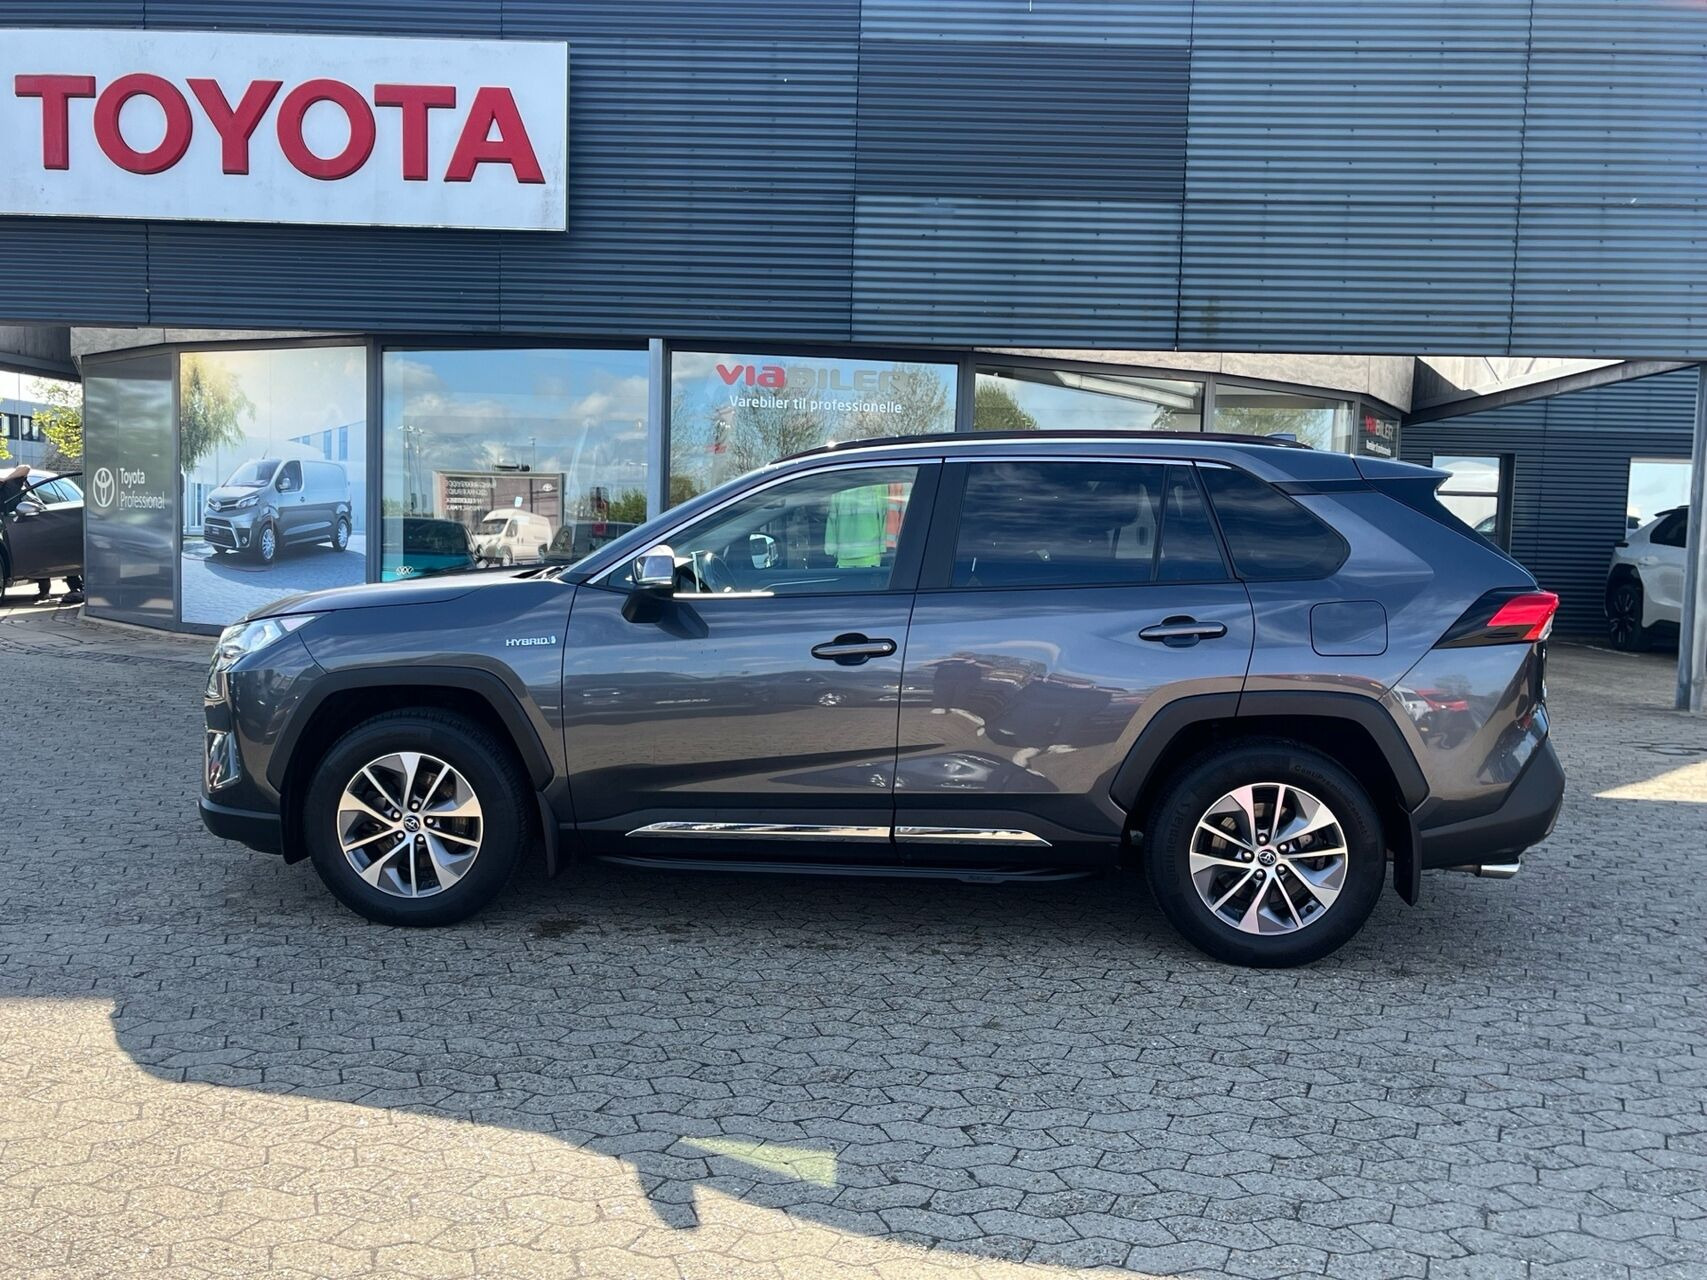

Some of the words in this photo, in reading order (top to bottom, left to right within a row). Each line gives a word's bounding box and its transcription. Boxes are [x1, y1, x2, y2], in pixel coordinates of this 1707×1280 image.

[15, 73, 546, 184] TOYOTA
[729, 395, 788, 409] Varebiler
[793, 398, 806, 410] til
[810, 400, 902, 414] professionelle
[120, 468, 145, 489] Toyota
[120, 490, 165, 509] Professional
[505, 637, 550, 647] HYBRID
